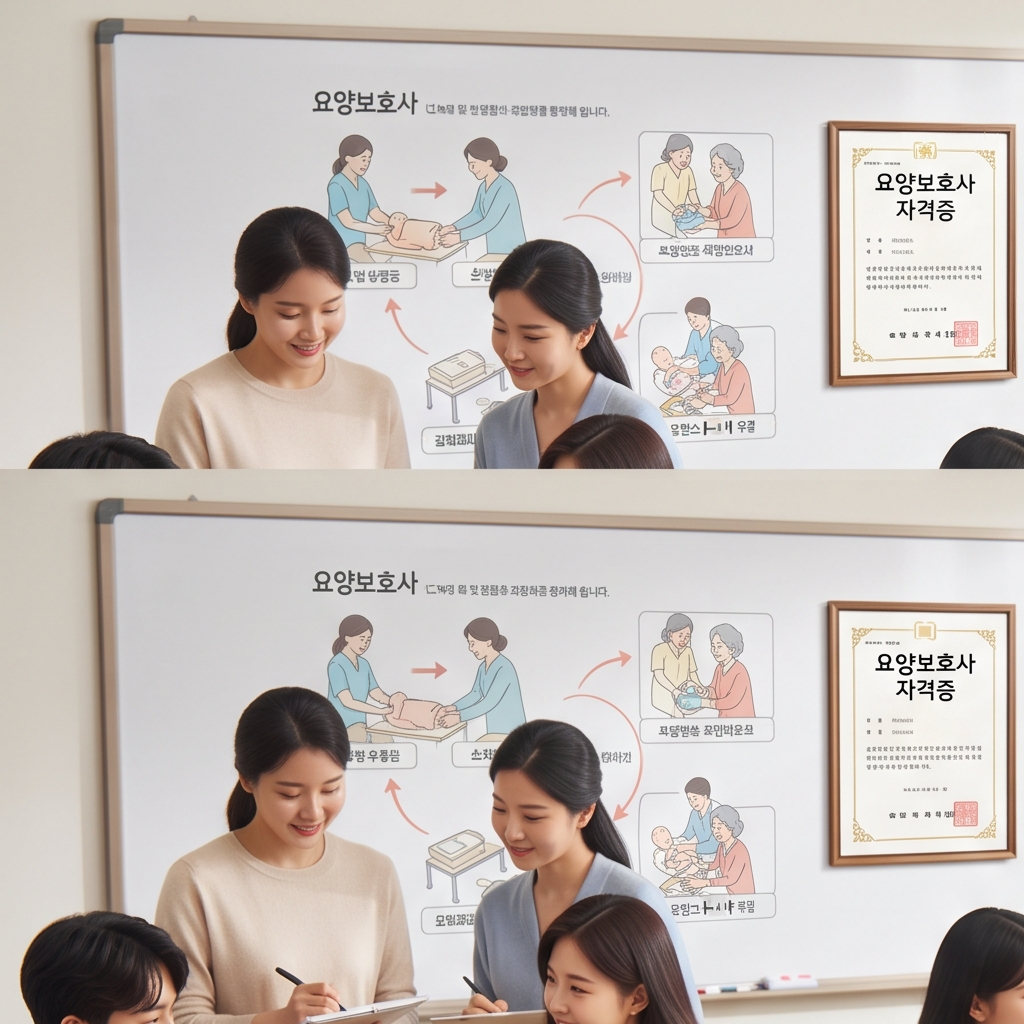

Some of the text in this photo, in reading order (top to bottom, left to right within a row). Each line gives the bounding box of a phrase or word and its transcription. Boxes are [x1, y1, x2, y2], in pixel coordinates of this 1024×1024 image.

[312, 90, 418, 115] 요양보호사
[875, 173, 975, 195] 요양보호사
[897, 199, 955, 221] 자격증
[312, 570, 418, 595] 요양보호사
[875, 653, 976, 676] 요양보호사
[896, 679, 955, 701] 자격증
